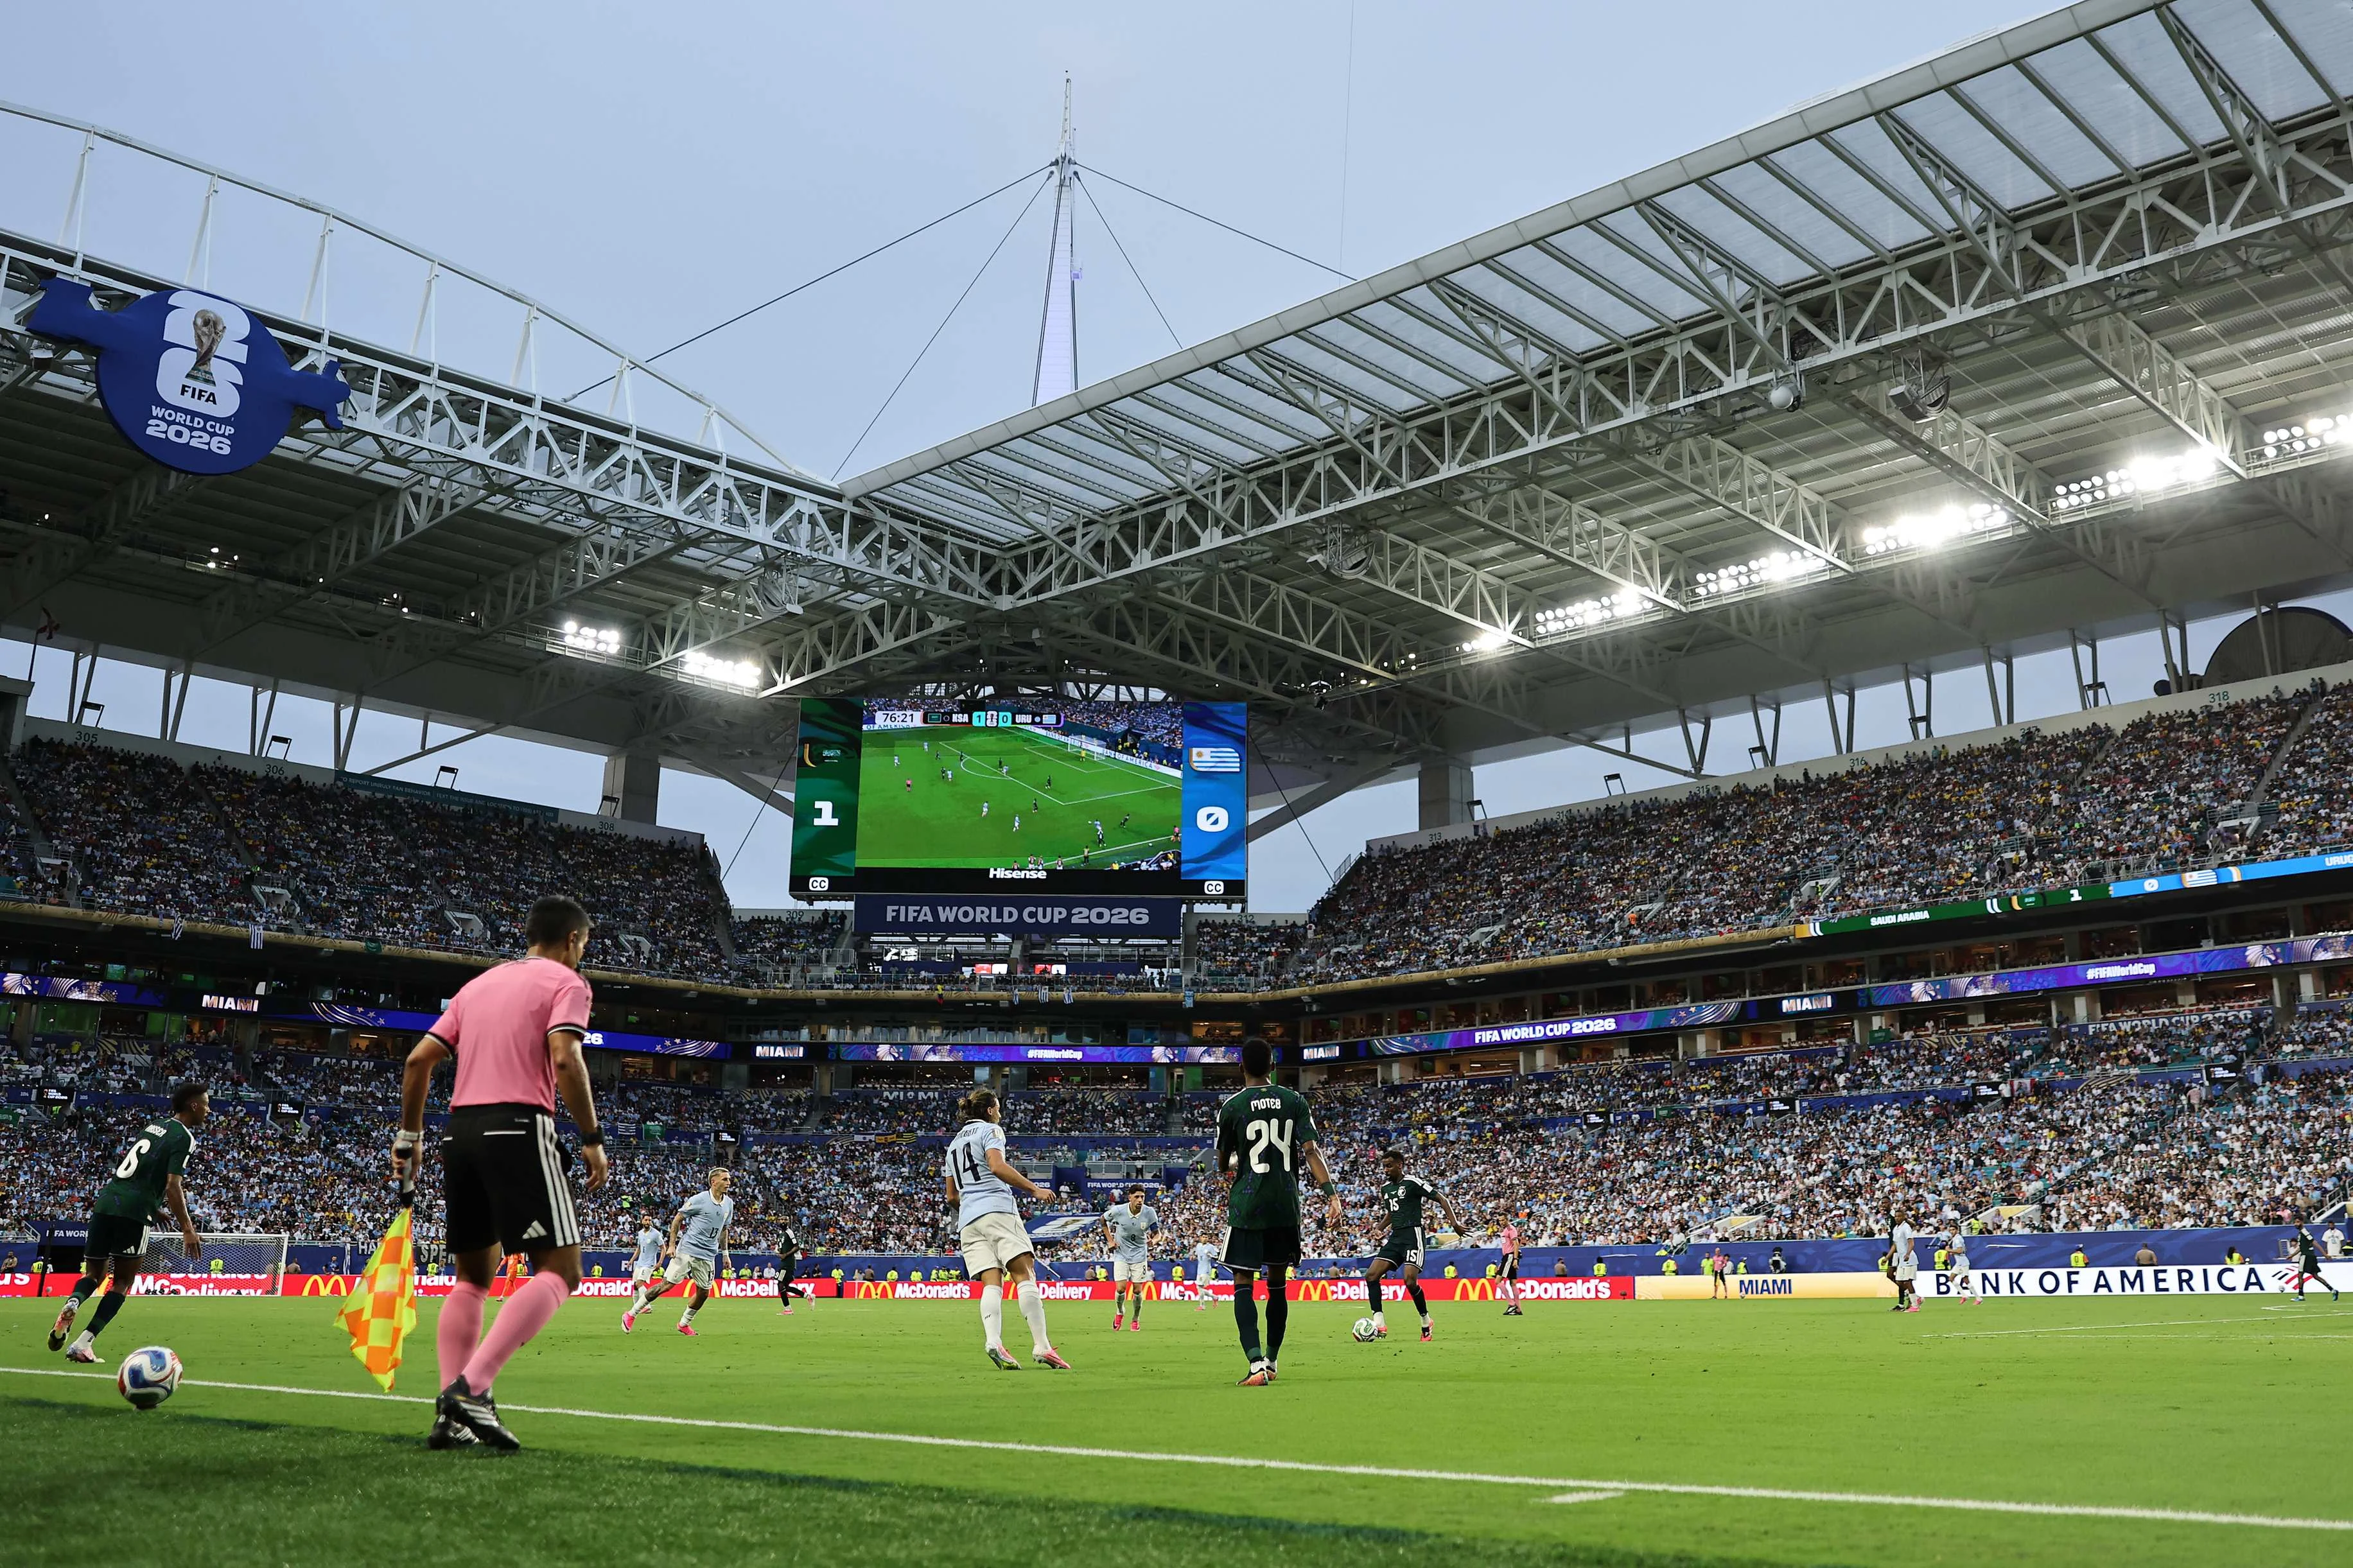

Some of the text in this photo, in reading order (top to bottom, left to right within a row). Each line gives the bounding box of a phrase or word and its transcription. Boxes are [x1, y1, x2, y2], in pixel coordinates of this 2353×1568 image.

[180, 383, 217, 405] FIFA
[151, 405, 234, 437] WORLD CUP
[145, 419, 232, 456] 2026
[2209, 691, 2230, 704] 318
[882, 713, 914, 723] 76:21
[952, 713, 969, 723] KSA
[976, 715, 981, 723] 1
[1002, 715, 1008, 723] 0
[1015, 714, 1032, 723] URU
[75, 731, 98, 744] 305
[1849, 756, 1866, 767] 316
[265, 764, 285, 776] 306
[813, 801, 839, 826] 1
[1196, 806, 1229, 832] 0
[598, 821, 615, 832] 308
[1428, 832, 1442, 842] 313
[989, 867, 1047, 878] Hisense
[810, 878, 827, 890] CC
[1207, 882, 1222, 893] CC
[2070, 889, 2083, 902] 1
[785, 910, 805, 920] 309
[886, 905, 1151, 925] FIFA WORLD CUP 2026
[1870, 910, 1930, 926] SAUDI ARABIA
[2085, 963, 2155, 980] #FIFAWorldCup
[202, 995, 259, 1012] MIAMI
[1781, 995, 1832, 1013] MIAMI
[1474, 1018, 1618, 1044] FIFA WORLD CUP 2026
[582, 1032, 602, 1045] 26
[755, 1045, 804, 1058] MIAMI
[1028, 1049, 1083, 1060] #FIFAWorldCup
[1303, 1046, 1340, 1059] MIAMI
[1250, 1098, 1281, 1112] MOTEB
[1246, 1118, 1293, 1174] 24
[116, 1139, 151, 1178] 6
[950, 1142, 982, 1190] 14
[1388, 1198, 1399, 1212] 15
[710, 1227, 719, 1239] 13
[1130, 1233, 1136, 1242] 8
[1406, 1249, 1417, 1262] 15
[1142, 1264, 1146, 1275] 8
[1739, 1279, 1792, 1294] MIAMI
[2038, 1271, 2079, 1294] OF
[2092, 1267, 2265, 1293] AMERICA
[894, 1283, 970, 1299] McDonald's
[1038, 1282, 1092, 1301] Delivery
